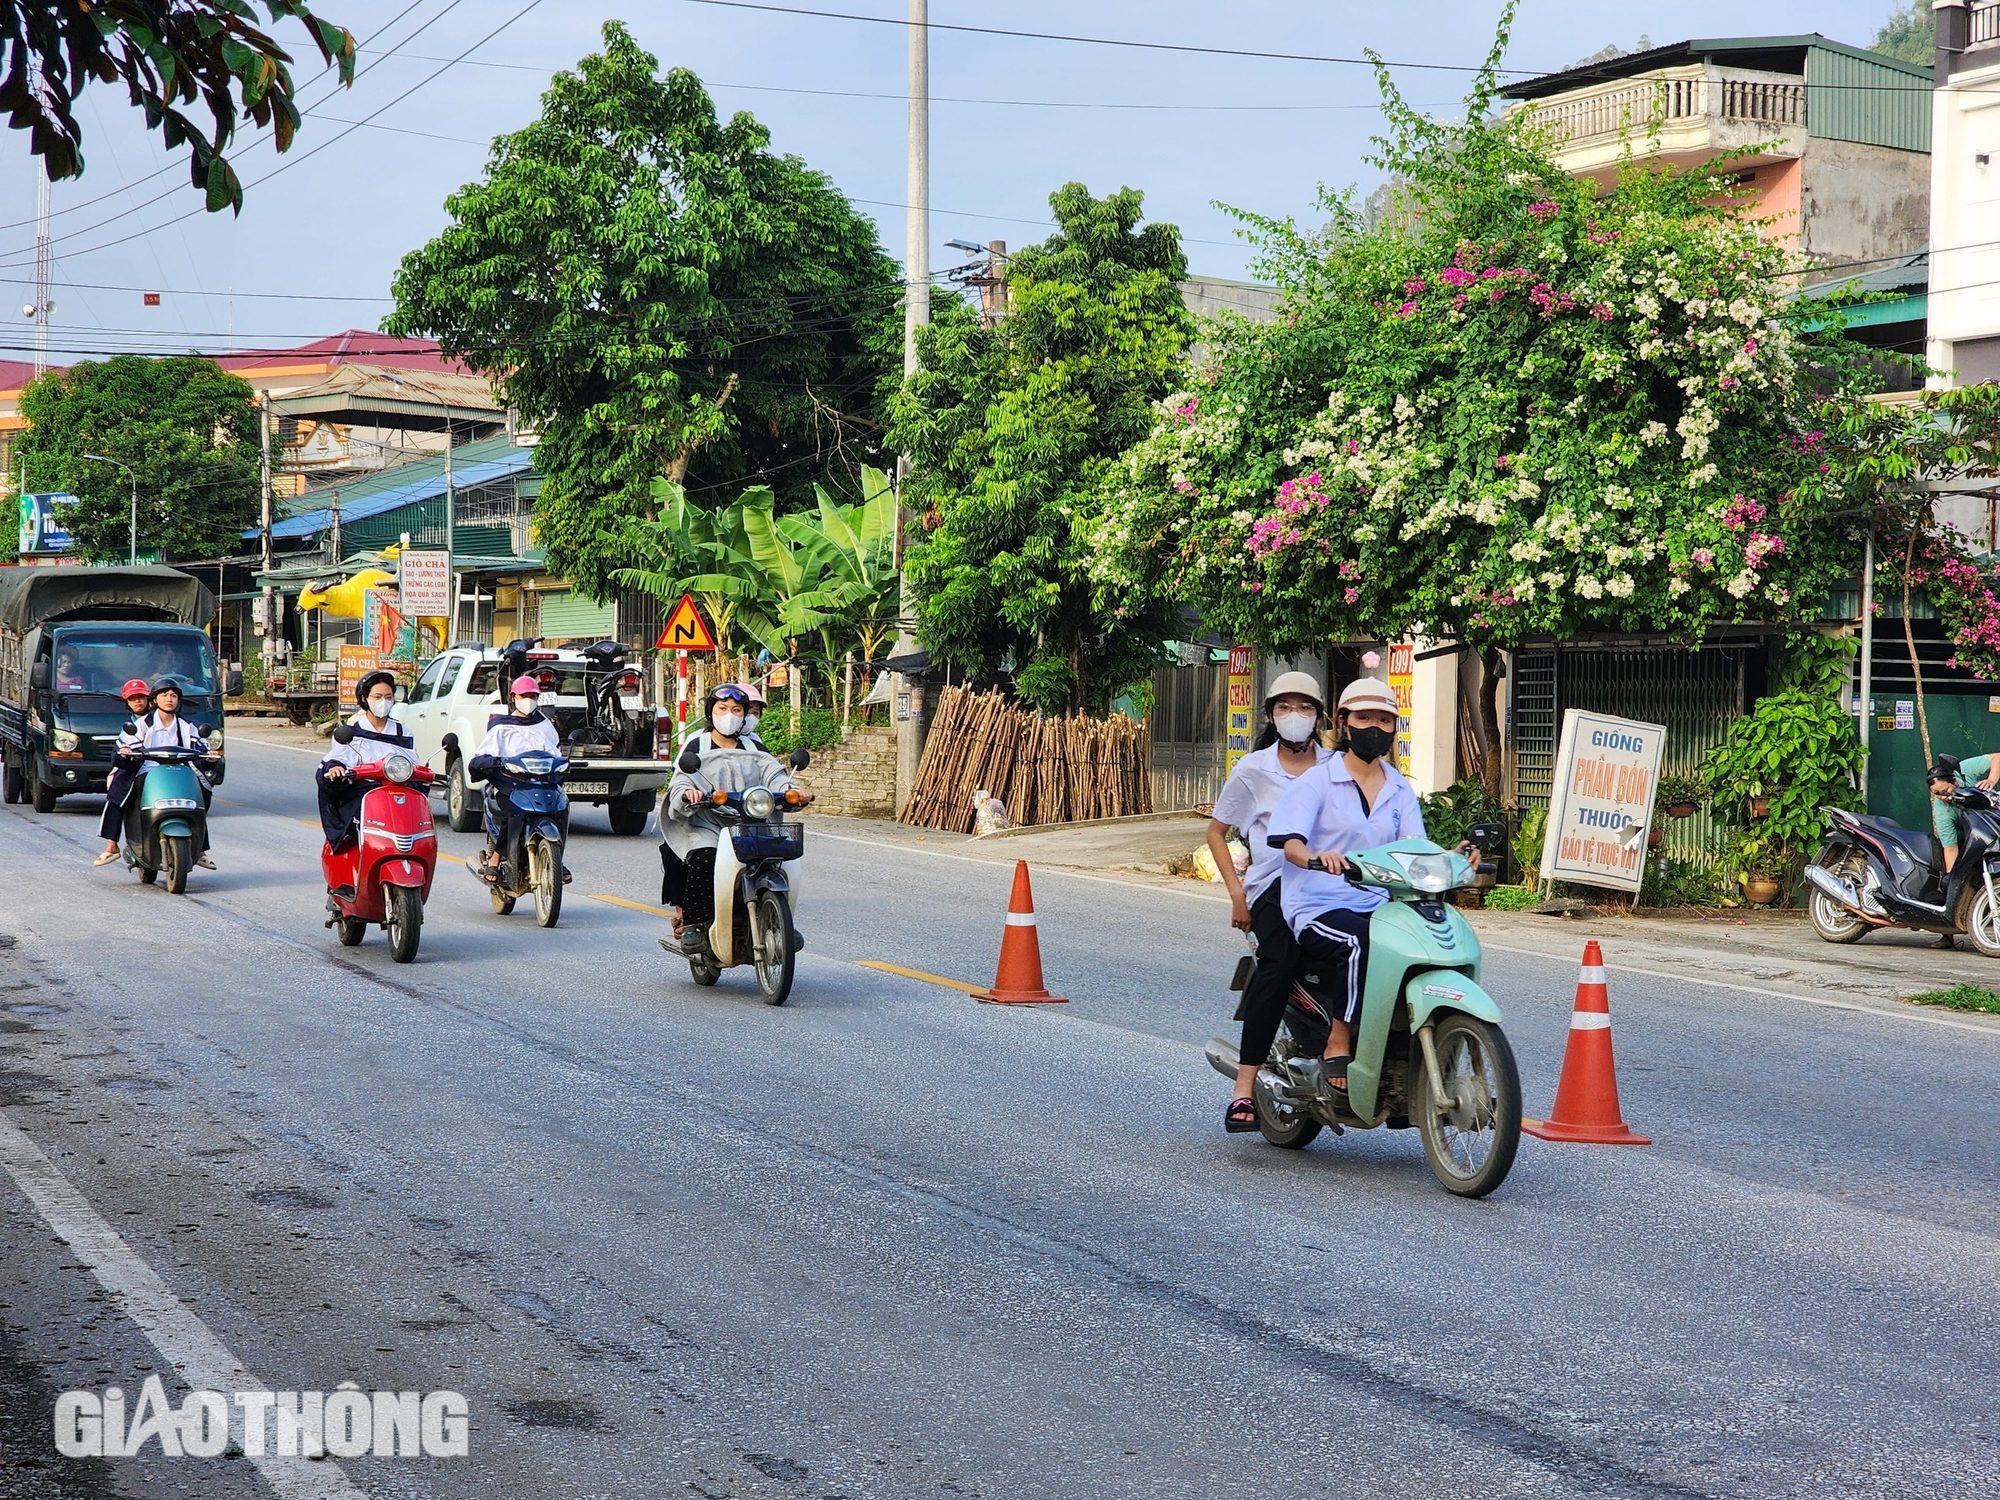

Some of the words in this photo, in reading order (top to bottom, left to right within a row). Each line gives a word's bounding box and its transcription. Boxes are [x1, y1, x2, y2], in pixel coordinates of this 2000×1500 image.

[405, 558, 422, 568] GIÒ
[425, 558, 446, 568] CHẢ
[341, 656, 357, 669] GIÒ
[358, 656, 378, 670] CHẢ
[1231, 651, 1251, 674] 1991
[1230, 678, 1251, 706] CHÁO
[1232, 712, 1248, 729] DINH
[1592, 728, 1644, 753] GIỐNG
[1573, 753, 1617, 800] PHÂN
[1617, 759, 1649, 806] BÓN
[1578, 807, 1633, 830] THUỐC
[1561, 829, 1582, 861] BẢO
[1582, 836, 1595, 867] VỆ
[1596, 842, 1620, 870] THỰC
